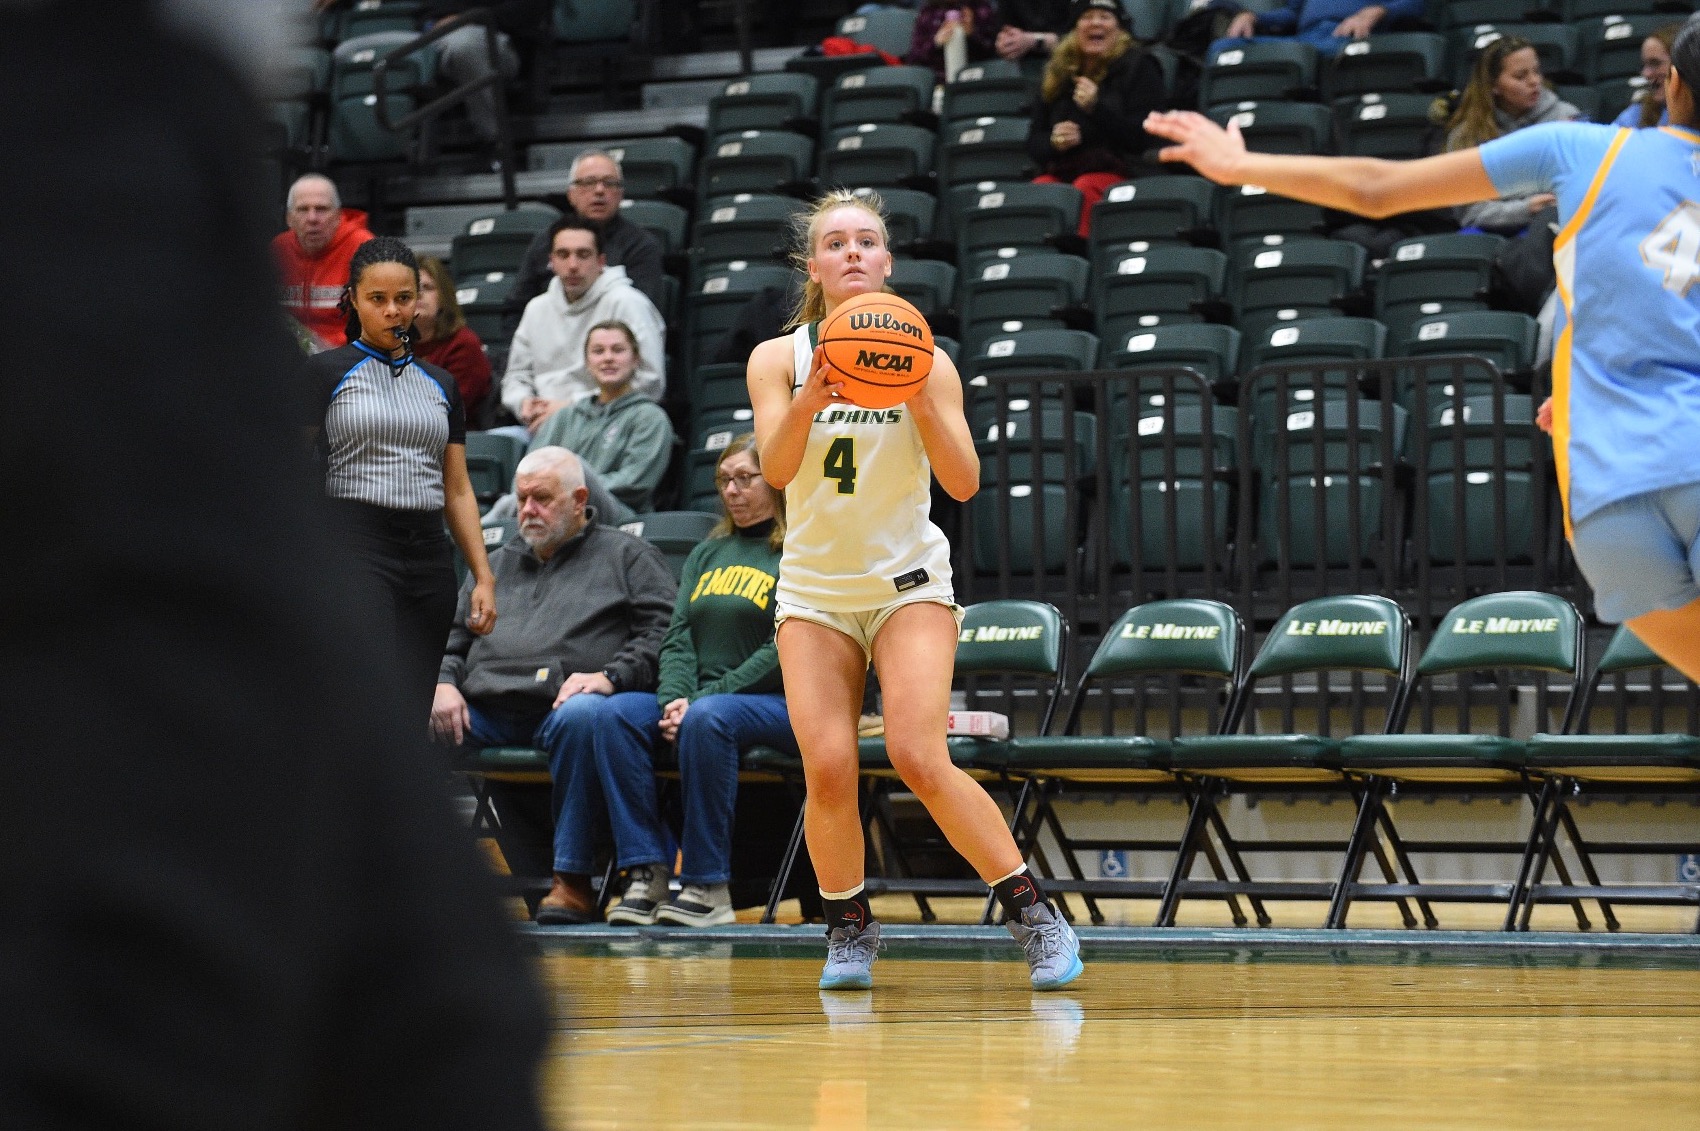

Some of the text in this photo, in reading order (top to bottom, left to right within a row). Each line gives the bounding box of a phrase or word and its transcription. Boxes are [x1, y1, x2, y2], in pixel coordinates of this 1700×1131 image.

[849, 312, 923, 341] Wilson
[855, 350, 913, 372] NCAA
[814, 409, 903, 424] LPHINS
[823, 436, 857, 496] 4
[702, 565, 776, 611] MOYNE
[958, 625, 1043, 642] E MOYNE
[1121, 623, 1220, 639] LE MOYNE
[1286, 620, 1387, 636] LE MOYNE
[1453, 617, 1559, 634] LE MOYNE
